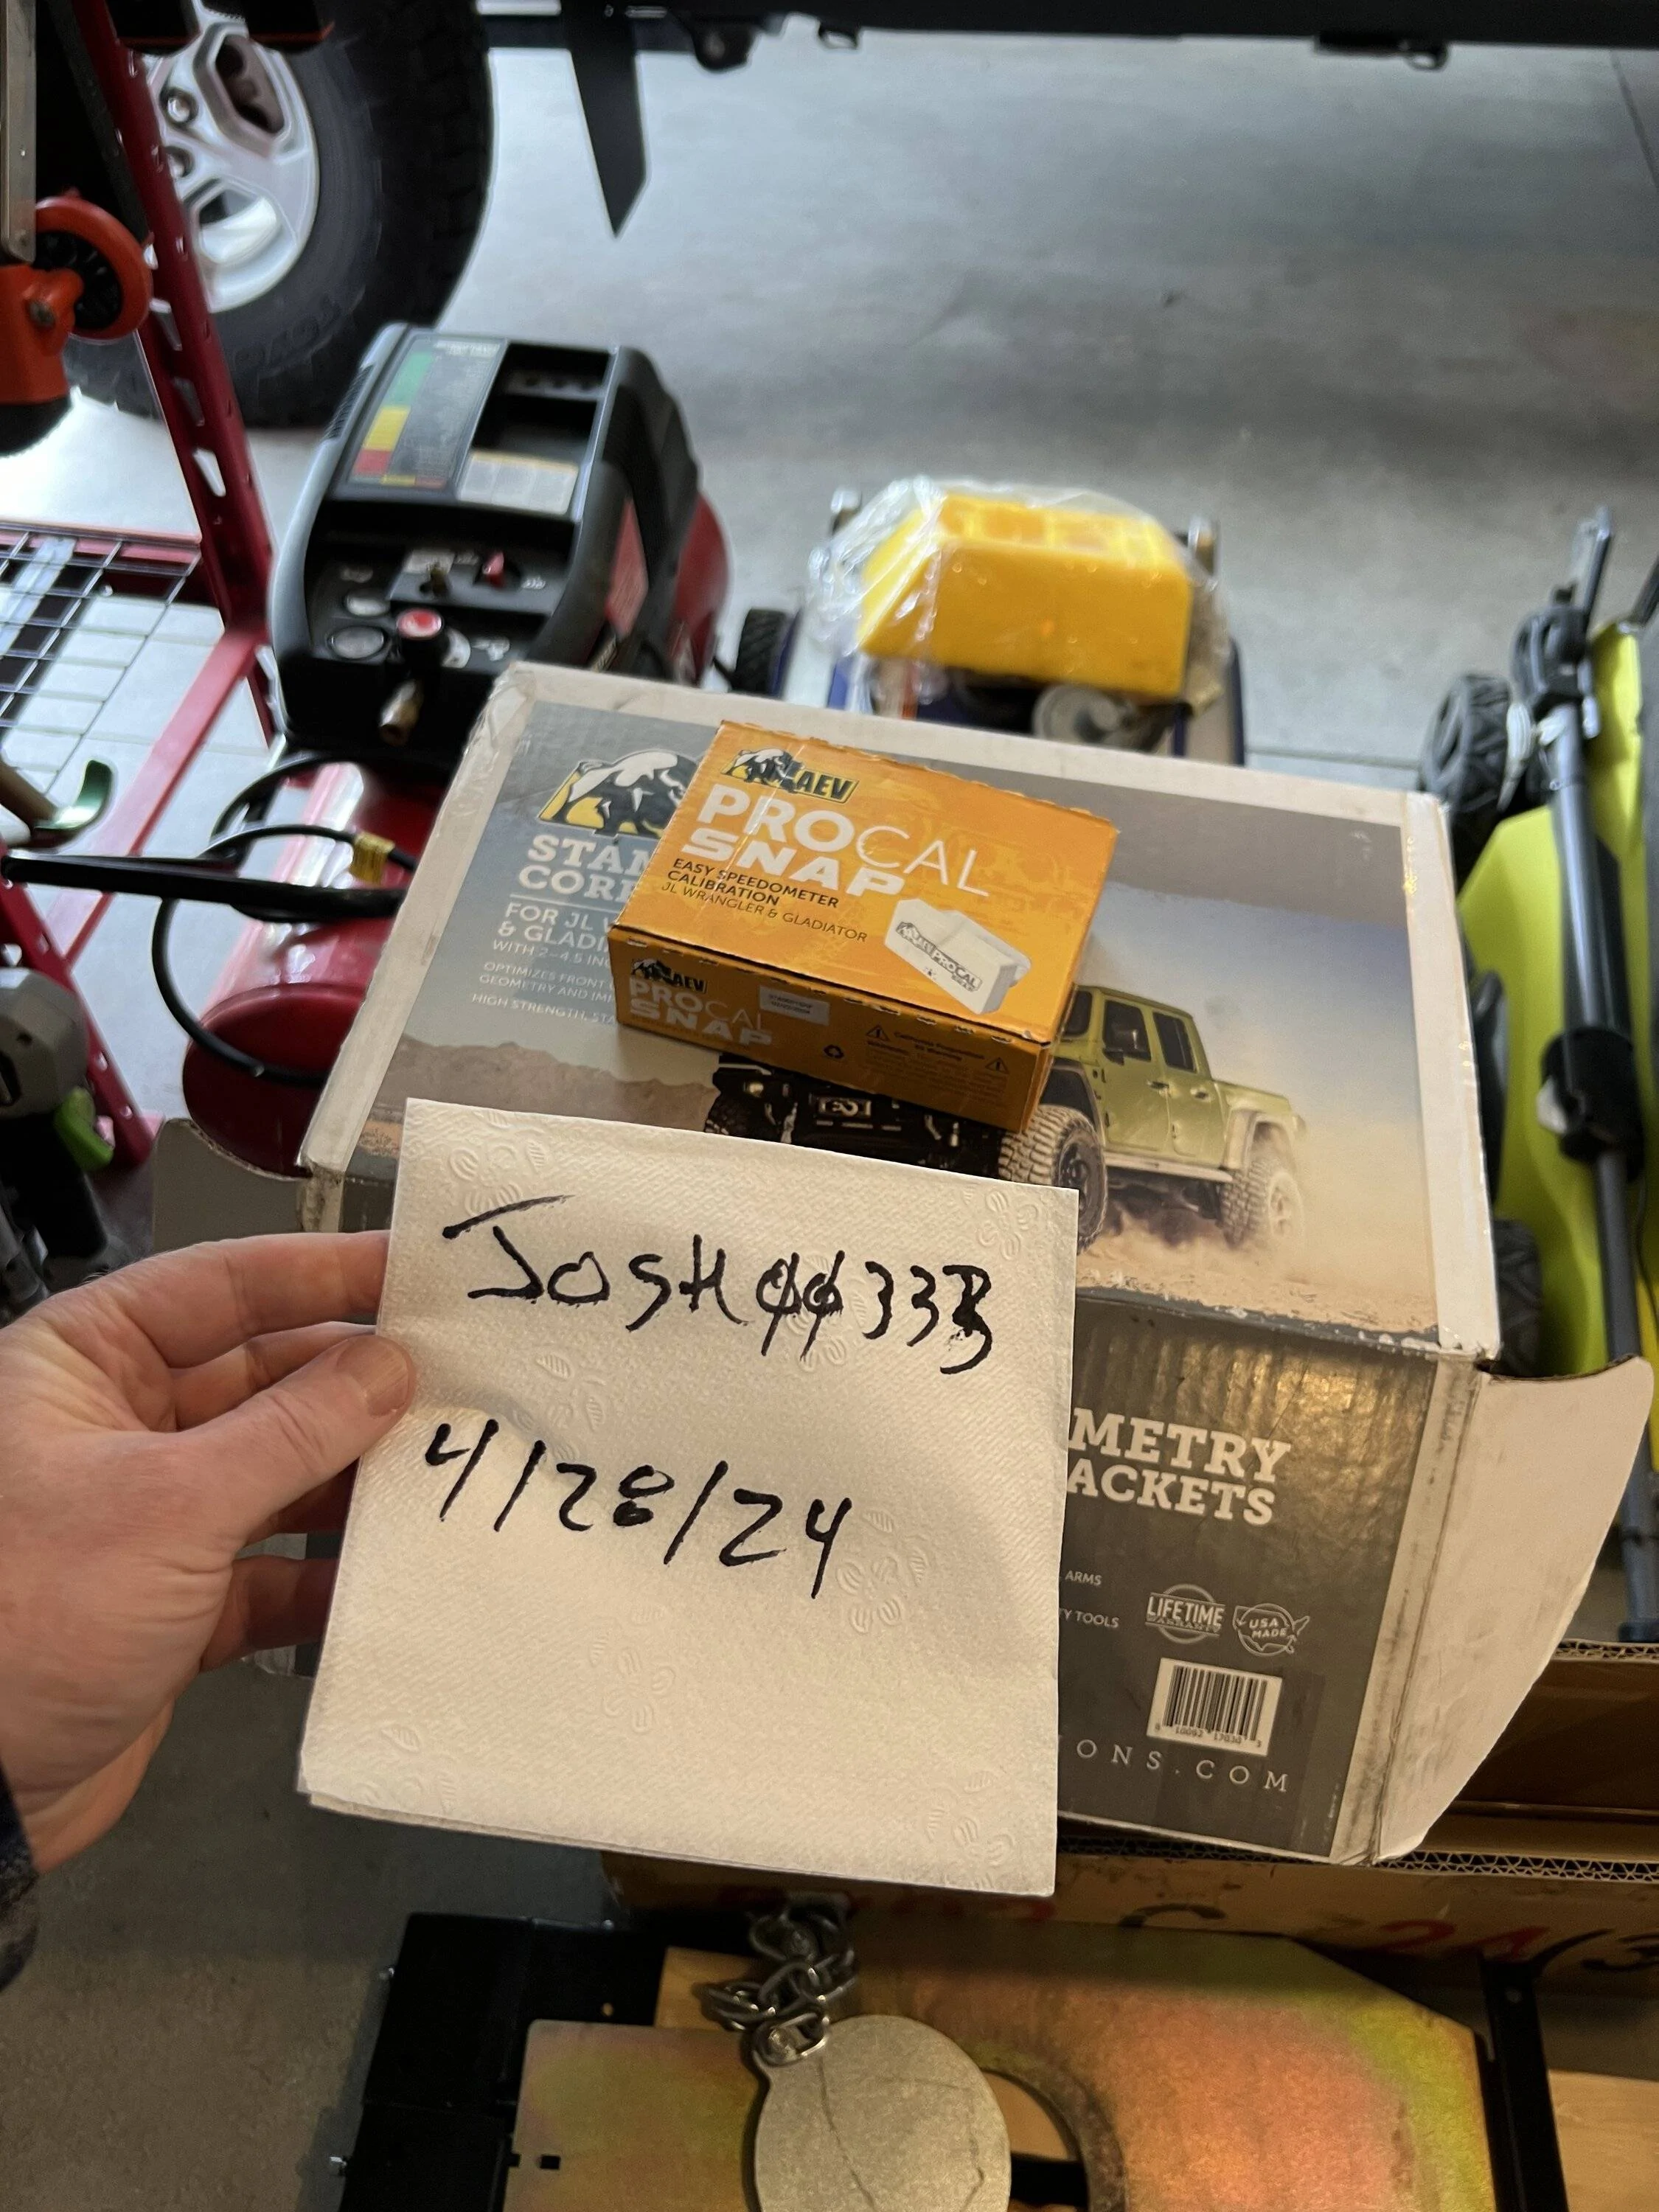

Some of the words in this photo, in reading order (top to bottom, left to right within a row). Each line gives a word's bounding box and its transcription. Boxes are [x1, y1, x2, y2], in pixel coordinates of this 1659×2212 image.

[796, 771, 853, 800] AEV
[697, 783, 990, 897] PROCAL
[681, 827, 905, 897] SNAP
[667, 870, 780, 906] CALIBRATION
[672, 858, 715, 876] EASY
[718, 869, 839, 908] SPEEDOMETER
[505, 902, 559, 925] FOR
[564, 911, 593, 931] JL
[661, 881, 678, 894] JL
[683, 886, 764, 917] WRANGLER
[767, 908, 777, 918] &
[782, 912, 868, 943] GLADIATOR
[493, 939, 535, 956] WITH
[498, 920, 515, 937] &
[524, 925, 609, 953] GLADI
[479, 973, 556, 994] GEOMETRY
[557, 987, 588, 1000] AND
[484, 961, 557, 981] OPTIMIZES
[560, 973, 605, 989] FRONT
[471, 992, 509, 1009] HIGH
[630, 998, 773, 1046] SNAP
[1068, 1407, 1291, 1484] METRY
[425, 1418, 853, 1599] 4/28/24
[1066, 1458, 1276, 1526] ACKETS
[1065, 1570, 1102, 1587] ARMS
[1075, 1610, 1120, 1629] TOOLS
[1147, 1596, 1225, 1630] LIFETIME
[1249, 1618, 1279, 1630] USA
[1251, 1627, 1289, 1639] MADE
